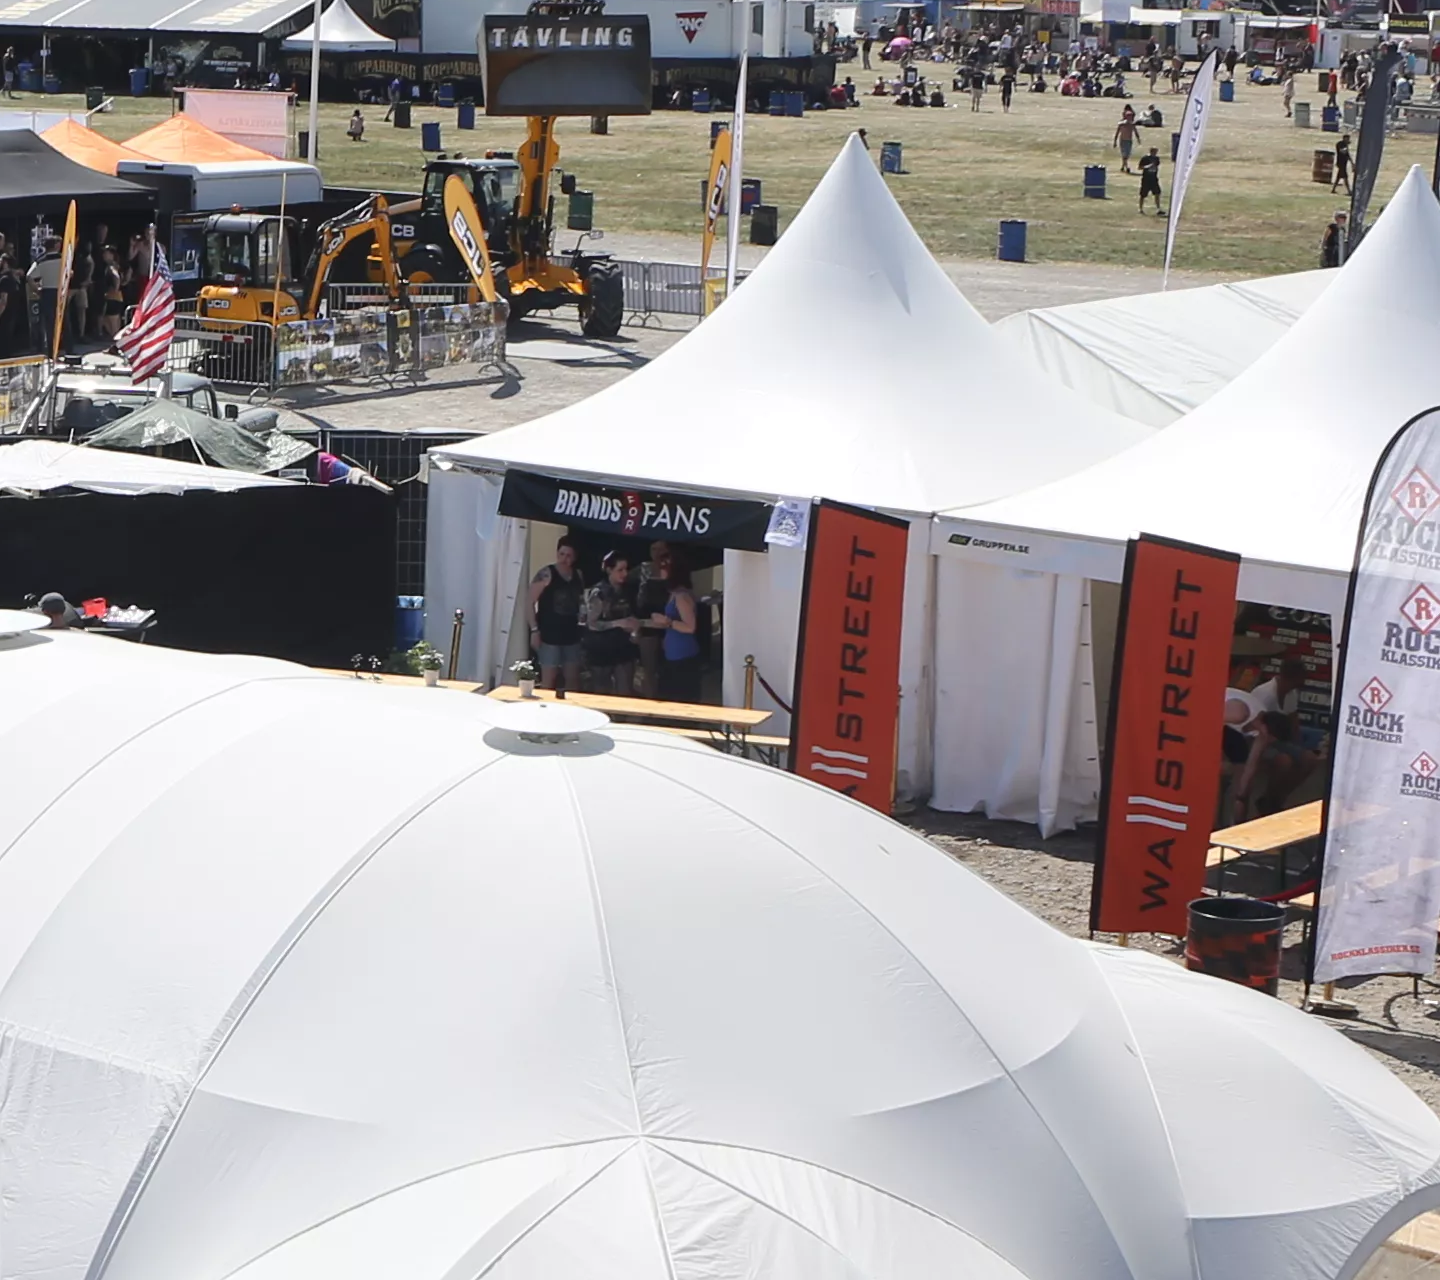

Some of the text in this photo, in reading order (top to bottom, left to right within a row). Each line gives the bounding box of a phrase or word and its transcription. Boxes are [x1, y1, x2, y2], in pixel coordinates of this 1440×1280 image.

[492, 26, 633, 48] TÄVLING
[391, 223, 415, 238] CB
[326, 230, 346, 256] JCB
[207, 298, 230, 310] JCB
[279, 305, 298, 317] JCB
[1407, 481, 1427, 509] R
[553, 488, 712, 535] BRANDS FOR FANS
[971, 538, 1031, 554] GRUPPEN.SE
[1414, 597, 1434, 621] R
[1370, 686, 1383, 705] R
[1346, 705, 1406, 734] ROCK
[1345, 724, 1403, 745] KLASSIKER
[1420, 759, 1431, 772] R
